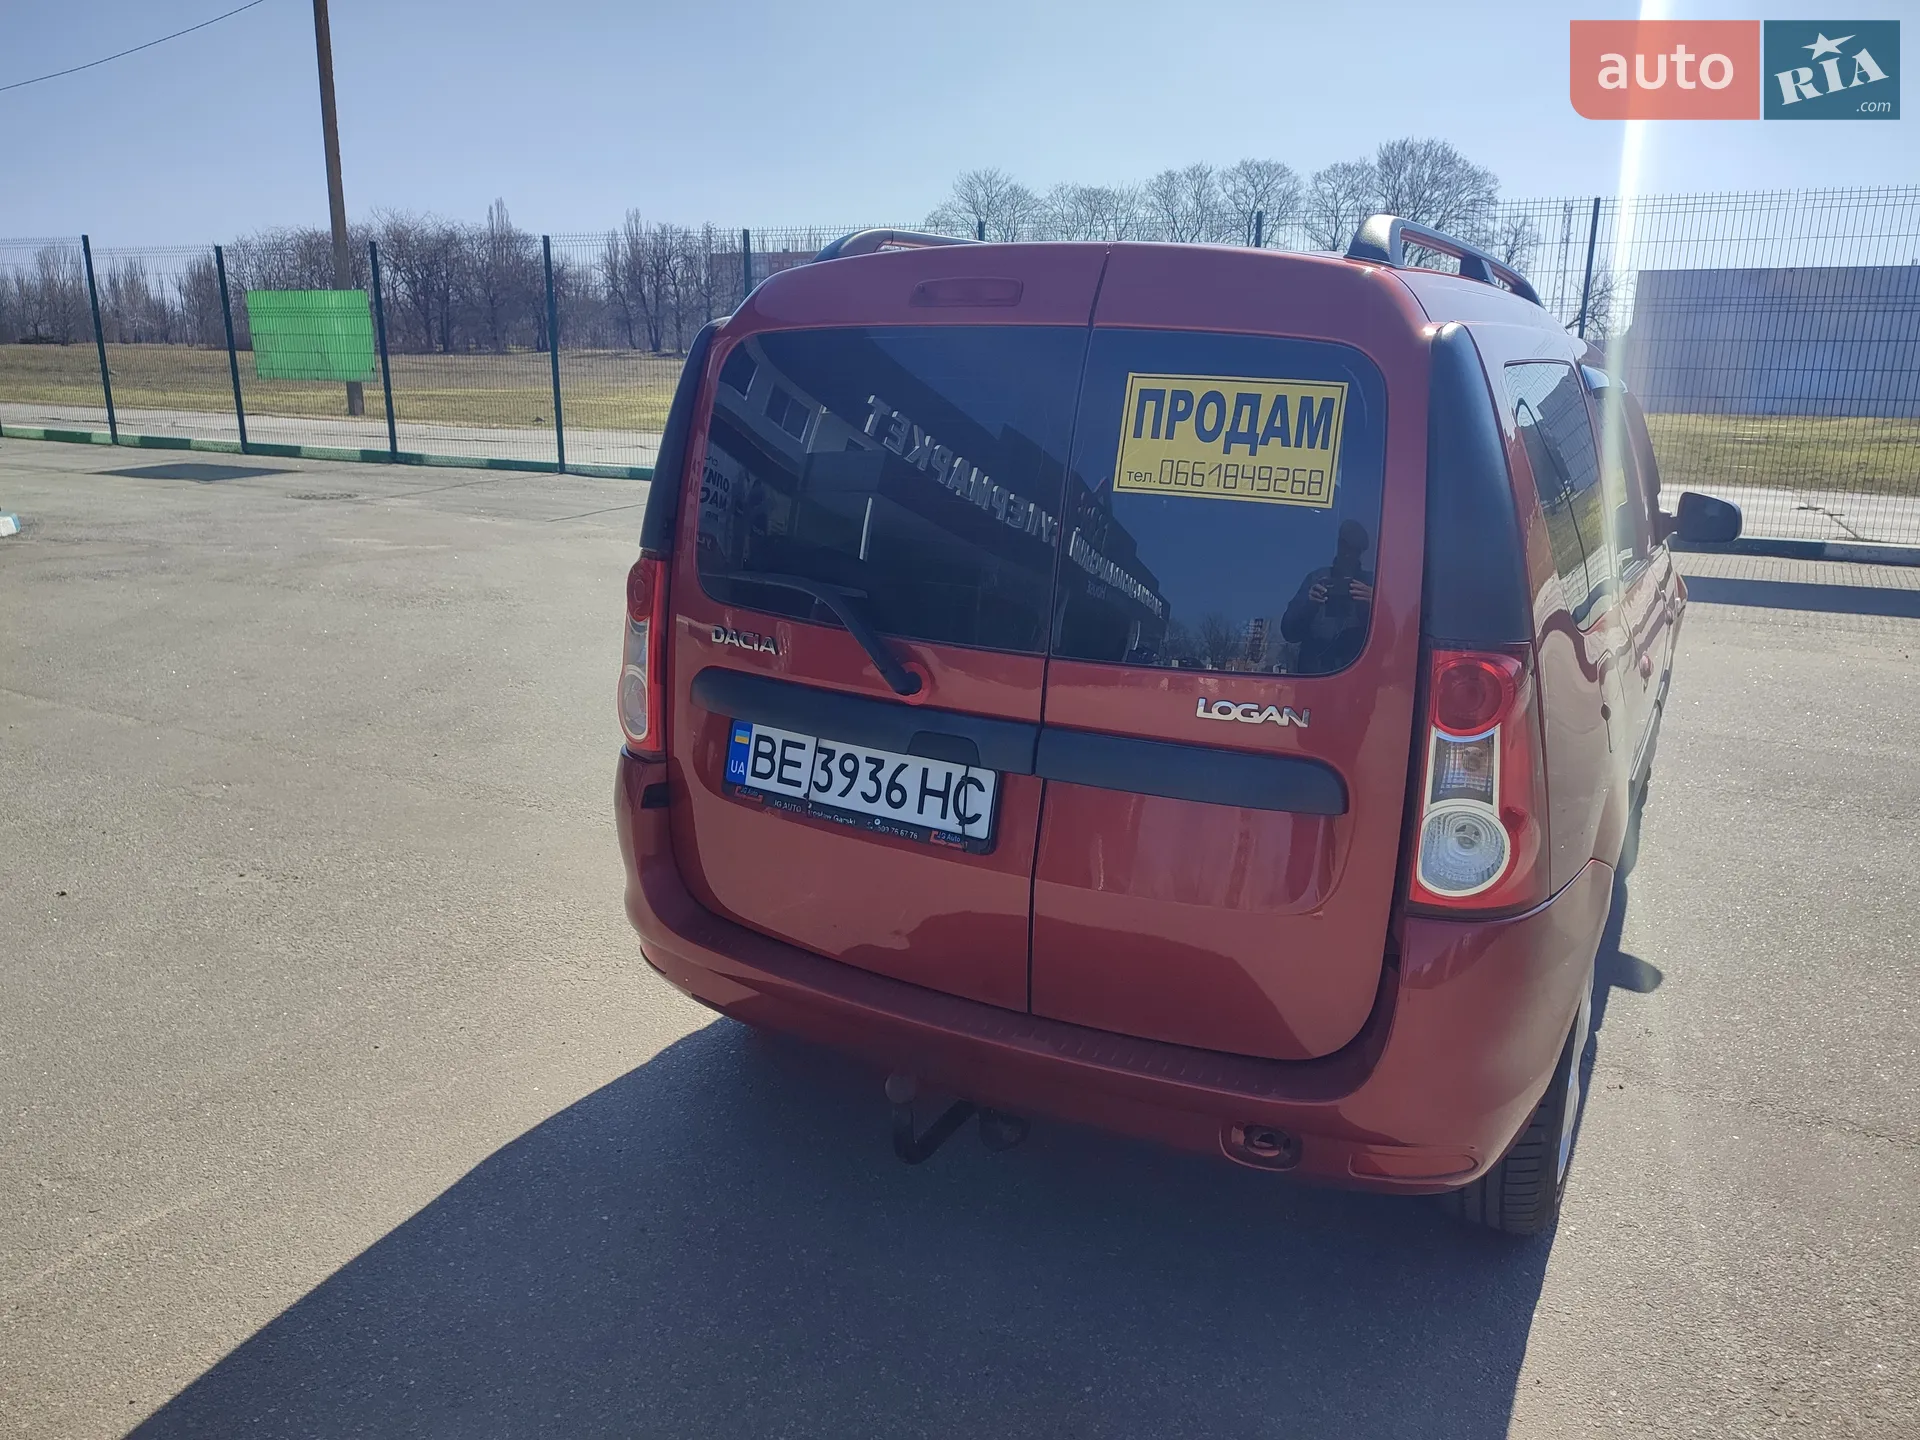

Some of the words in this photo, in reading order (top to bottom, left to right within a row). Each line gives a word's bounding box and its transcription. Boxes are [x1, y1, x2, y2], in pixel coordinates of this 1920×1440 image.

[1133, 388, 1336, 456] ПРОДАМ
[1127, 469, 1156, 483] тел.
[1159, 460, 1324, 496] 0661849268
[711, 625, 778, 655] DACIA
[1196, 697, 1310, 728] LOGAN
[730, 759, 746, 776] UA
